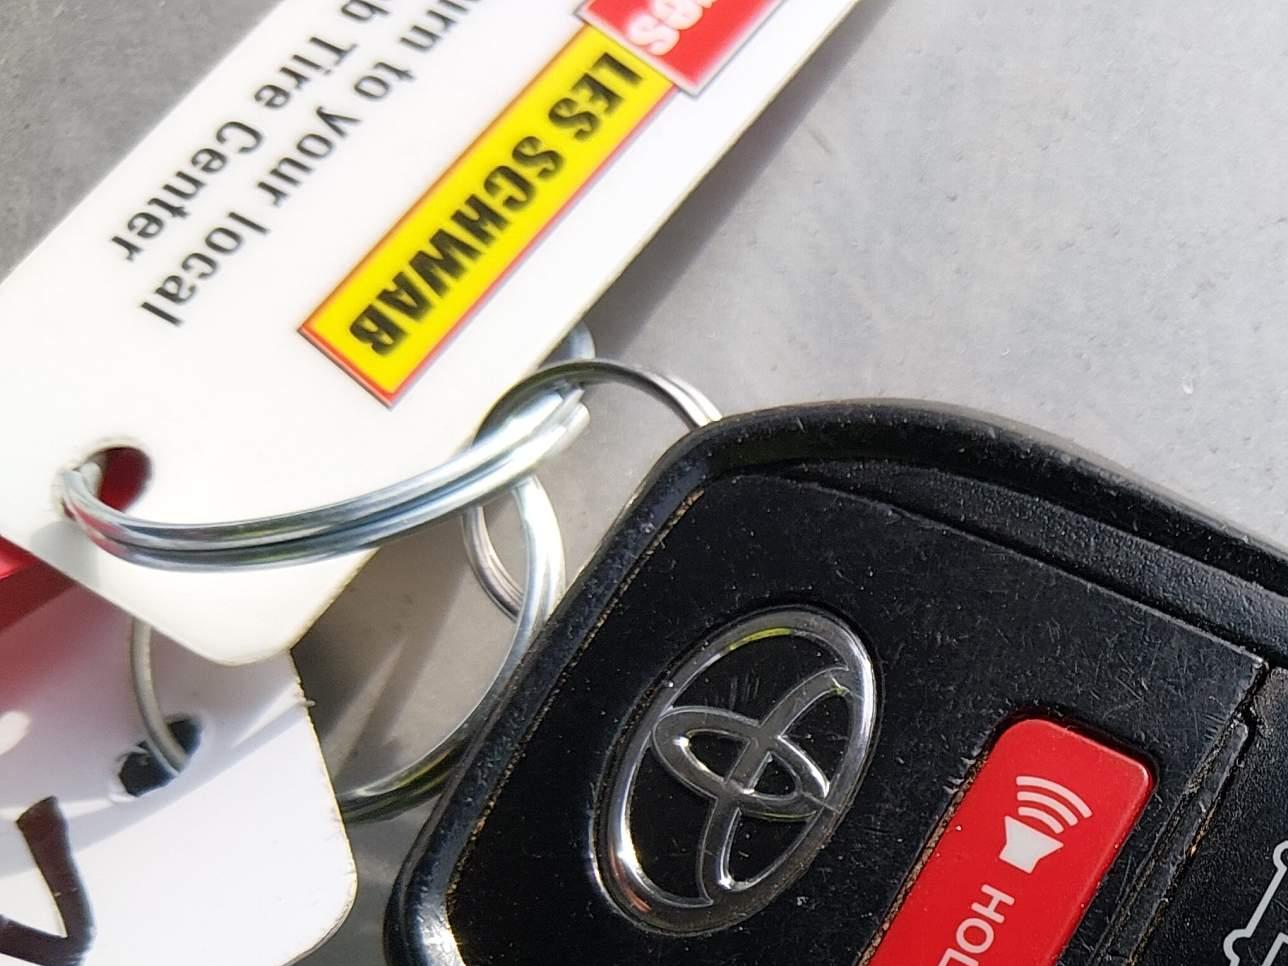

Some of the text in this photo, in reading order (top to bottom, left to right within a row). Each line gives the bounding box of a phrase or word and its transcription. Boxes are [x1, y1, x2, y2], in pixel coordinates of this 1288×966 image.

[254, 36, 357, 110] Tire
[625, 0, 716, 56] es
[354, 62, 415, 101] to
[111, 121, 264, 262] Center
[257, 106, 361, 206] your
[349, 52, 644, 355] LES SCHWAB
[141, 212, 270, 326] local
